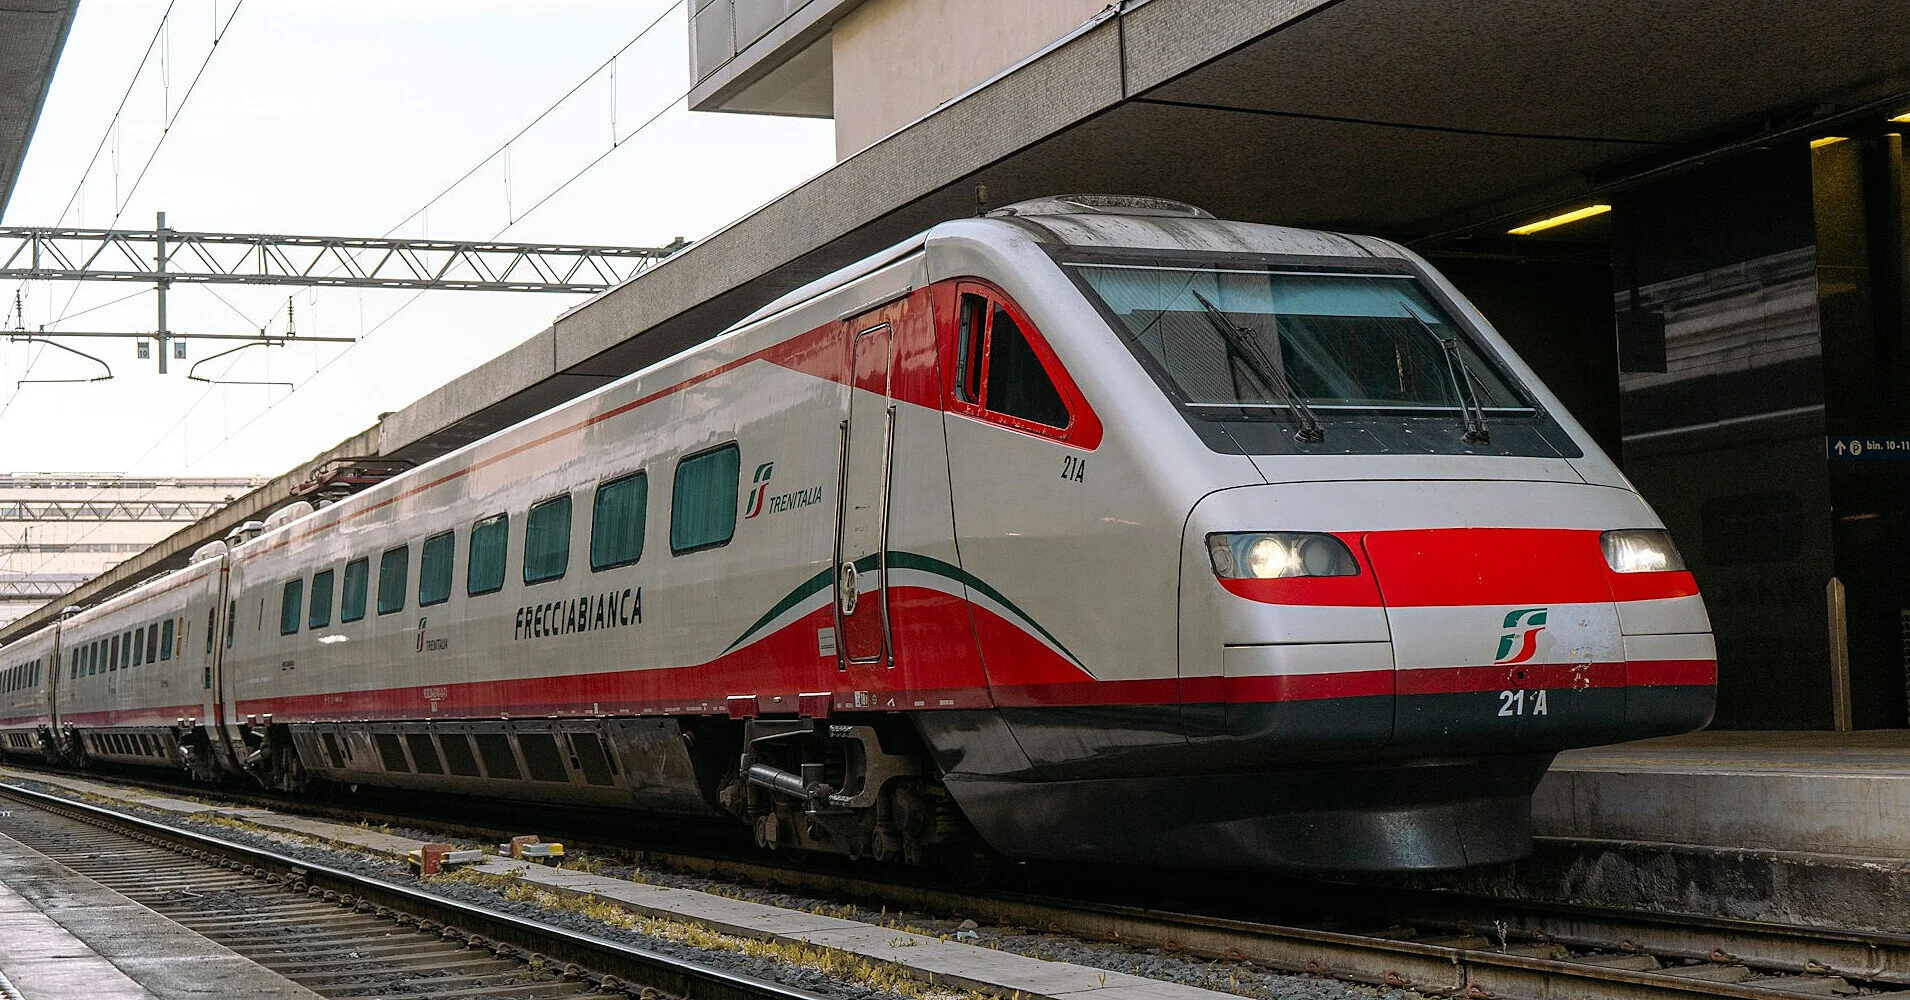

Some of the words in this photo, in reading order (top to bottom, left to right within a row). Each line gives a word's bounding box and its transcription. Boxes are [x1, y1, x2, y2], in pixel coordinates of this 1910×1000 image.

[1866, 440, 1883, 450] bin.
[1061, 455, 1085, 483] 21A
[769, 485, 822, 514] TRENITALIA
[514, 586, 642, 640] FRECCIABIANCA
